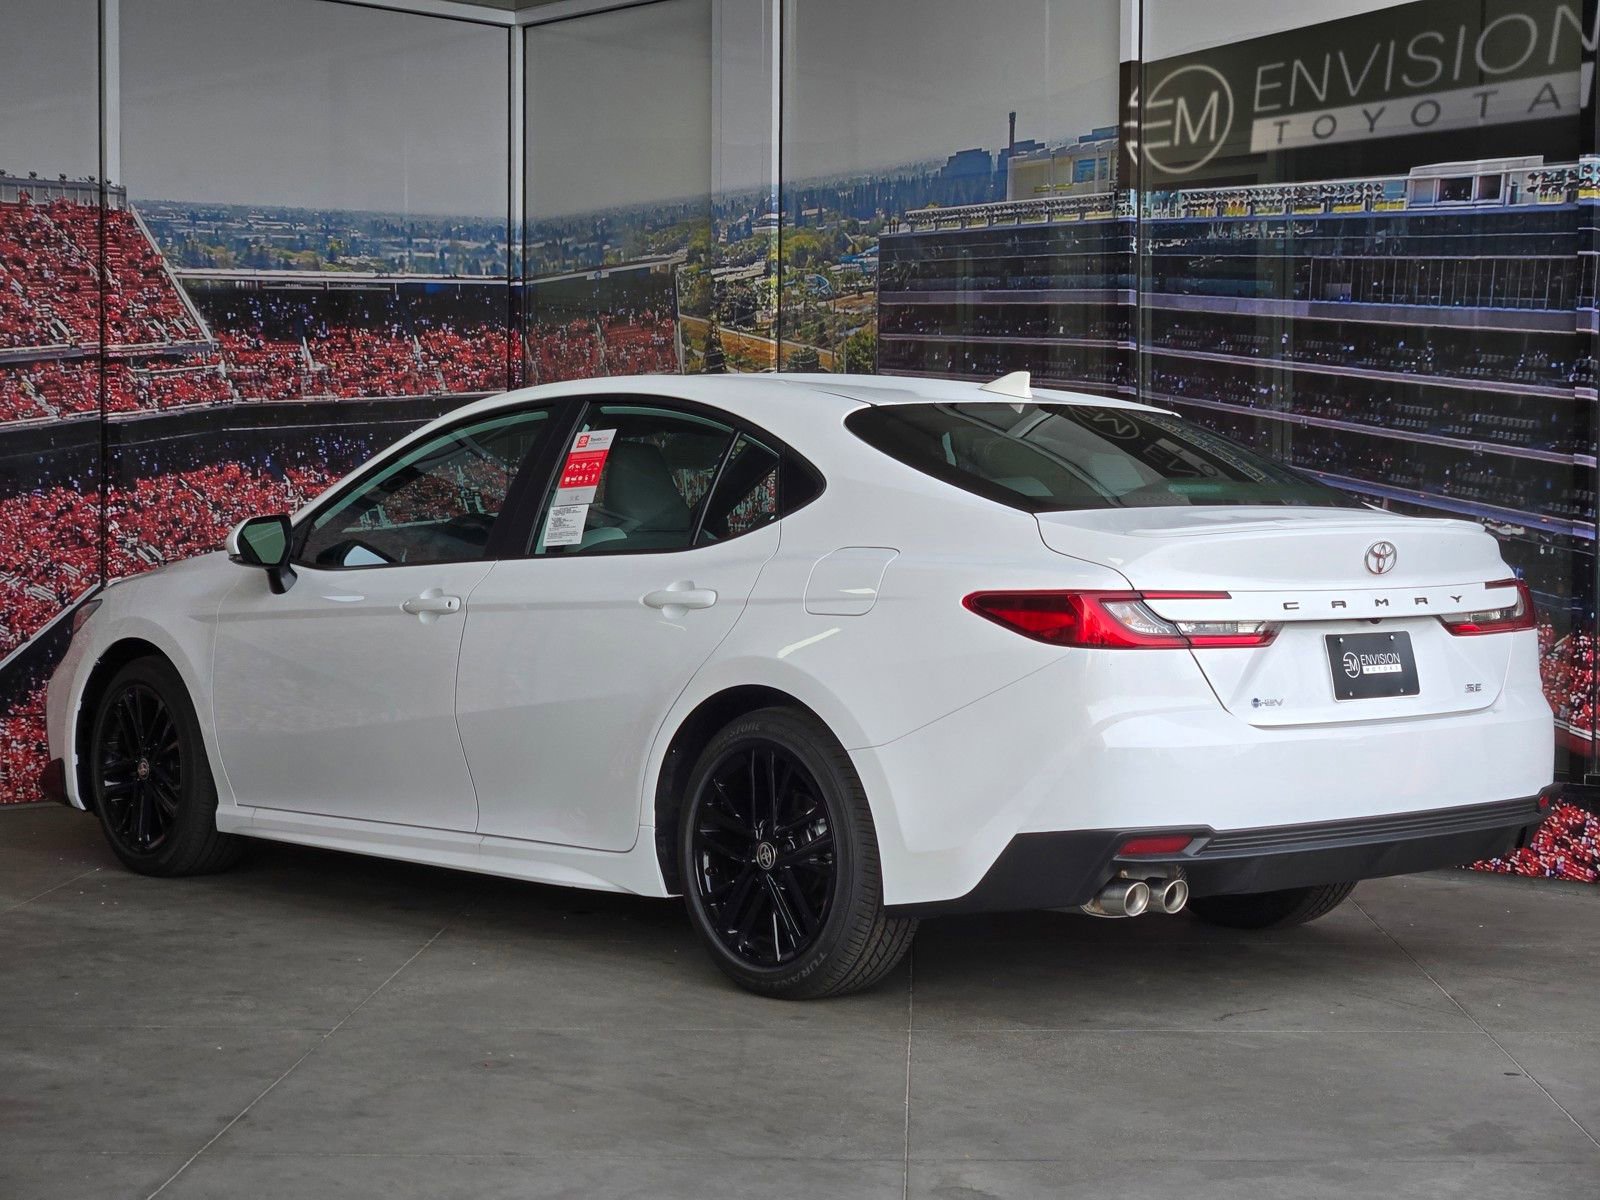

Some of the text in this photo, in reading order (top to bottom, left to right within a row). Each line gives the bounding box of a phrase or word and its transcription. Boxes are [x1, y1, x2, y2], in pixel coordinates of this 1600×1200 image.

[1254, 3, 1600, 112] ENVISION
[1273, 82, 1562, 144] TOYOTA
[1283, 594, 1463, 610] CAMRY
[1360, 652, 1401, 666] ENVISION
[1465, 683, 1482, 693] SE
